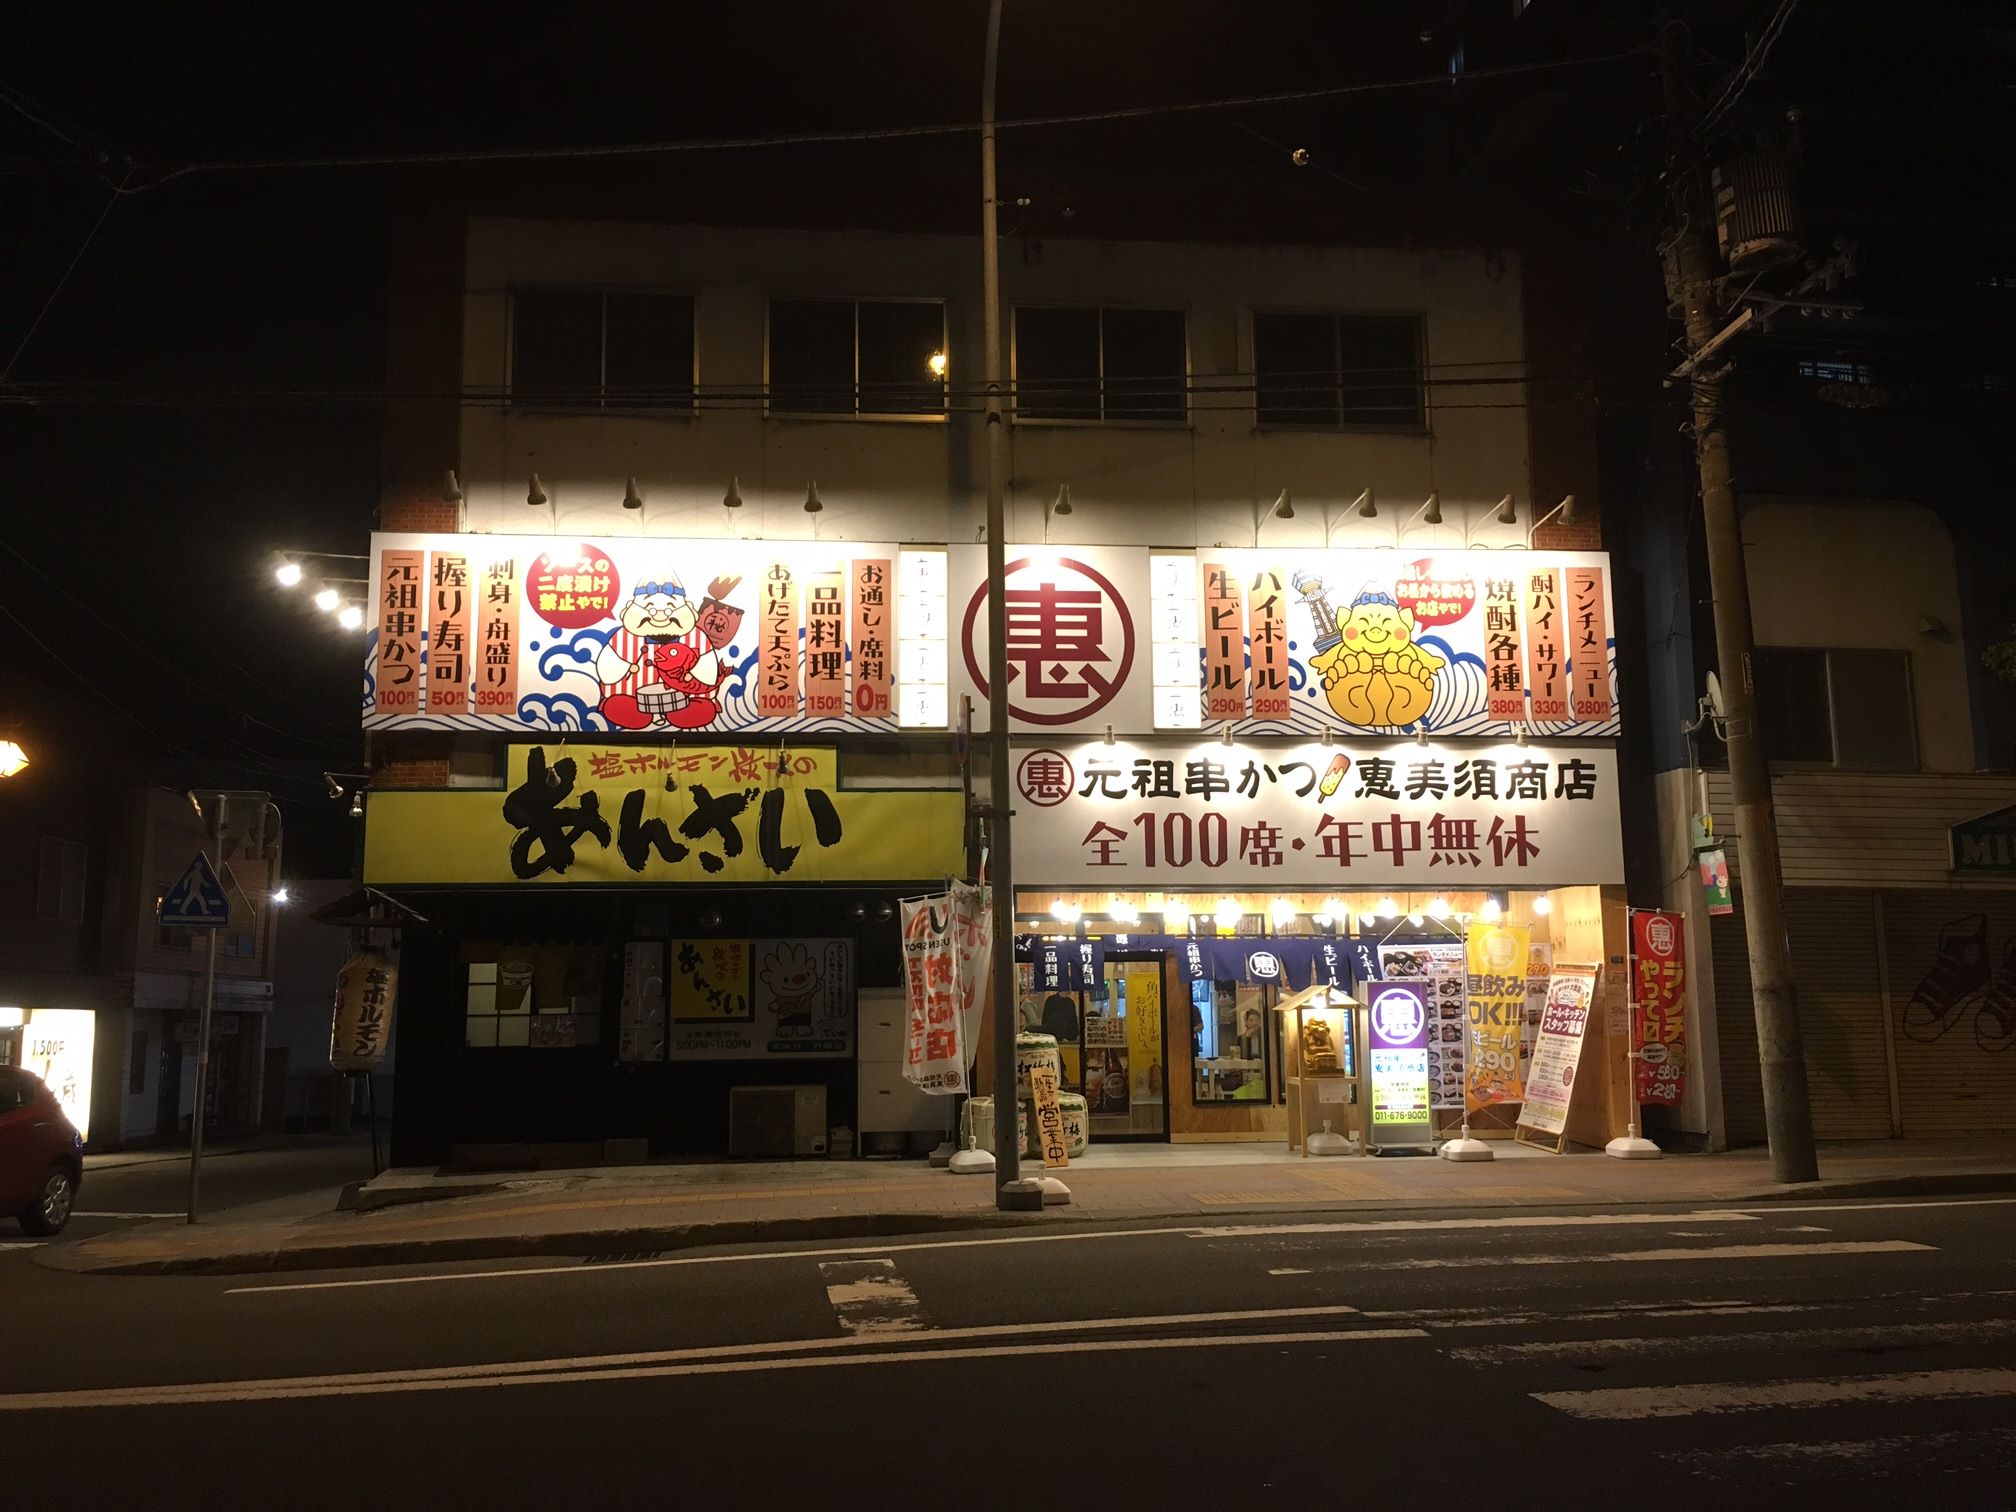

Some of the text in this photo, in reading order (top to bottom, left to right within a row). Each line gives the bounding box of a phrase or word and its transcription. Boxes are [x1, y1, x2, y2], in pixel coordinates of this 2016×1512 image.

[383, 557, 419, 685] 元祖串かつ
[432, 557, 467, 684] 握り寿司
[484, 558, 514, 688] 刺身・舟盛り
[767, 563, 791, 691] あげたて天ぷら
[808, 571, 843, 681] 一品料理
[859, 564, 884, 681] お通し・席料
[1208, 570, 1242, 691] 生ビール
[1251, 571, 1286, 691] ハイボール
[1484, 577, 1521, 692] 焼酎各種
[1531, 574, 1558, 697] 酎ハイ・サワー
[1573, 574, 1603, 698] ランチメニュー
[856, 683, 888, 712] 0円
[1211, 699, 1244, 713] 290円
[1077, 756, 1317, 802] 元祖串かつ
[1081, 811, 1541, 868] 全100席・年中無休
[1043, 945, 1059, 987] 一品料理
[1079, 943, 1095, 985] 握り寿司
[1186, 942, 1204, 977] 元祖串かつ
[1323, 944, 1341, 986] 生ビール
[1357, 945, 1378, 982] ハイボール
[1662, 960, 1684, 1043] ランチ
[1038, 1100, 1065, 1163] 営業中
[1374, 1110, 1428, 1120] 011-676-9000
